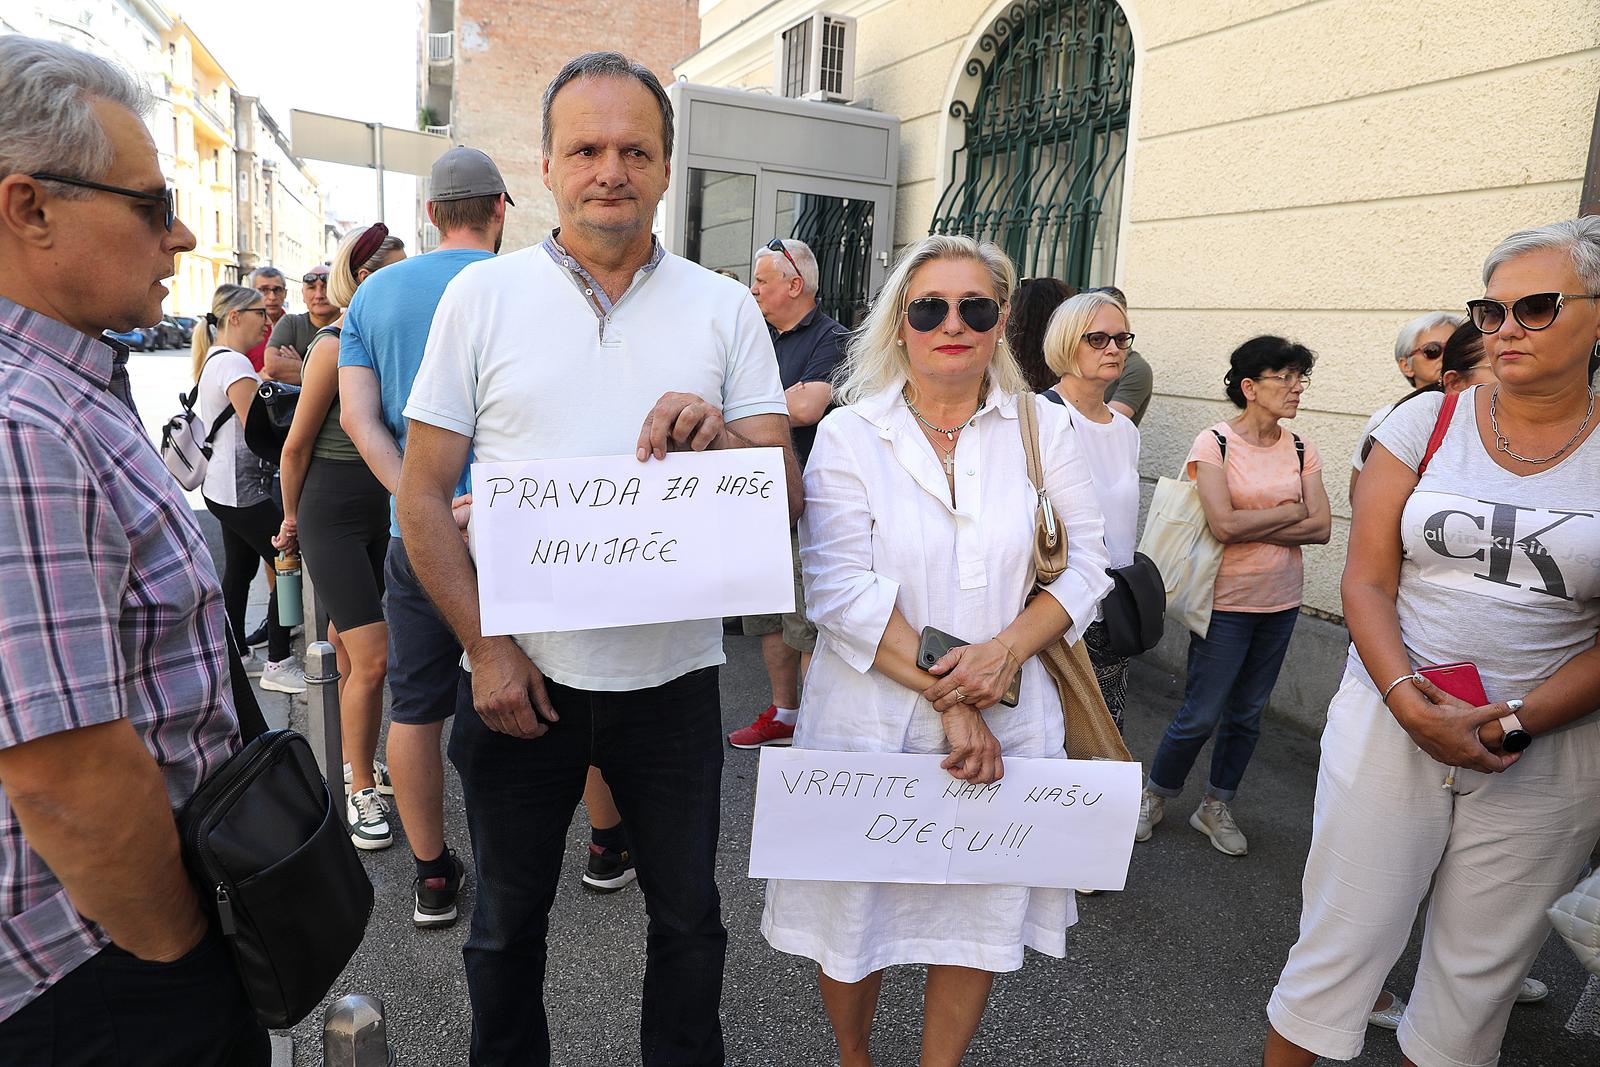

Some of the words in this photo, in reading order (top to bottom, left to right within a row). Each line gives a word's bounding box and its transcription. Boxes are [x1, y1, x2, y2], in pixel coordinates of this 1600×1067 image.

[486, 477, 641, 510] PRAVDA
[661, 476, 700, 502] ZA
[715, 471, 774, 499] NAŠE
[530, 531, 678, 565] NAVIJAČE
[780, 769, 920, 799] VRATITE
[942, 780, 1002, 803] NAM
[1023, 785, 1103, 807] NAŠU
[864, 813, 1034, 858] DJECU!!!
